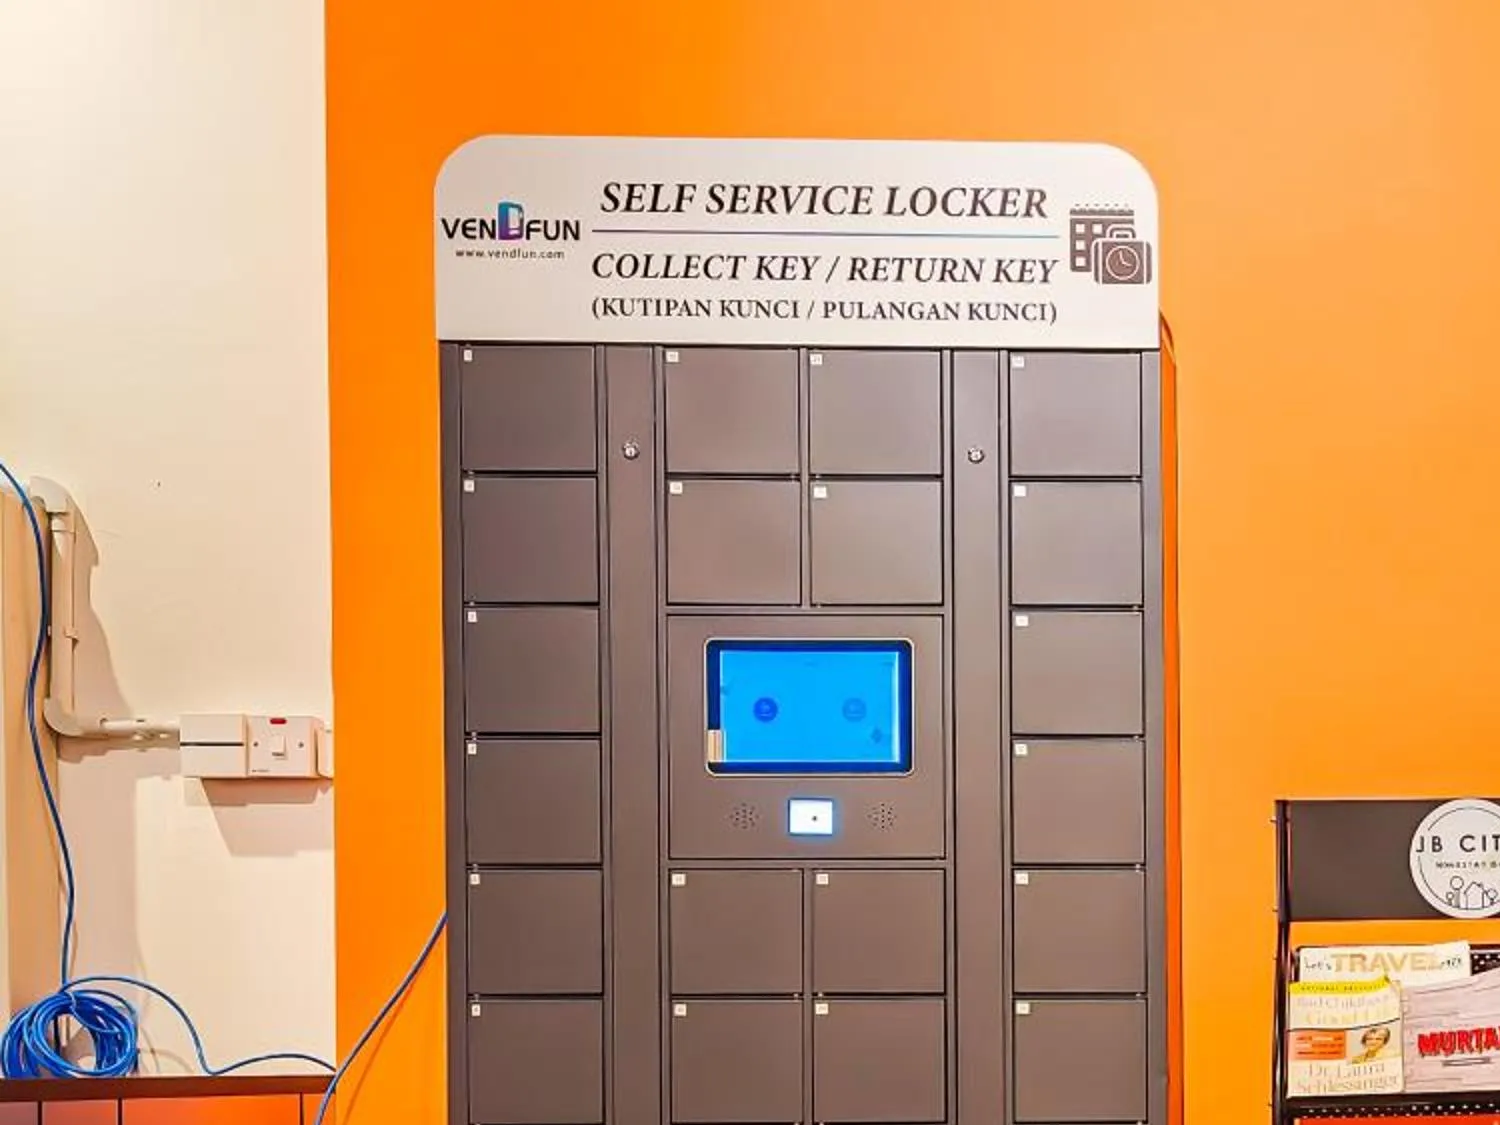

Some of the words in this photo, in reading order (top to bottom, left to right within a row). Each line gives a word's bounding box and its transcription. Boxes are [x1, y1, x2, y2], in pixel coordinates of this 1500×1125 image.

[600, 182, 697, 214] SELF
[705, 183, 873, 216] SERVICE
[886, 186, 1049, 218] LOCKER
[456, 249, 565, 260] www.vendfun.com
[592, 252, 747, 280] COLLECT
[753, 255, 821, 281] KEY
[825, 255, 841, 284] /
[848, 256, 985, 283] RETURN
[992, 258, 1060, 284] KEY
[591, 296, 712, 320] (KUTIPAN
[720, 299, 800, 320] KUNCI
[806, 300, 815, 322] /
[823, 301, 960, 322] PULANGAN
[967, 301, 1057, 326] KUNCI)
[1415, 836, 1443, 853] JB
[1331, 952, 1443, 973] TRAVEL
